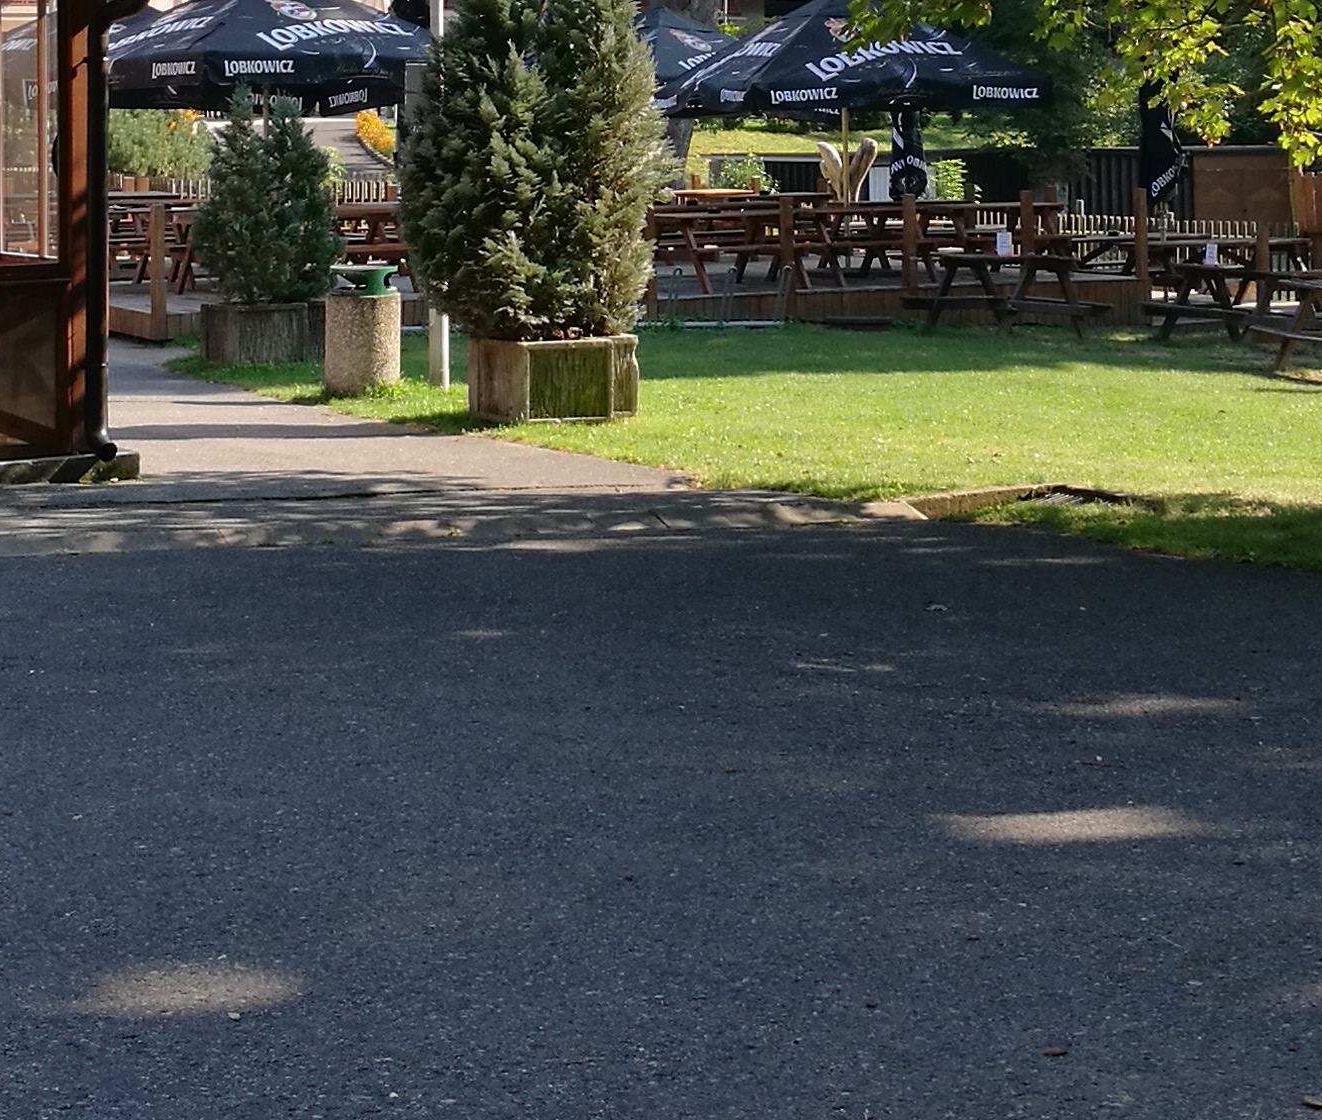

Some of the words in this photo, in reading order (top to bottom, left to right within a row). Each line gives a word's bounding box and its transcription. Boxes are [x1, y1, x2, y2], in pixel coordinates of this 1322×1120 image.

[256, 19, 414, 51] LOBKOWICZ
[151, 61, 196, 79] LOBKOWICZ
[224, 59, 295, 77] LOBKOWICZ
[770, 87, 839, 105] LOBKOWICZ
[972, 84, 1040, 100] LOBKOWICZ
